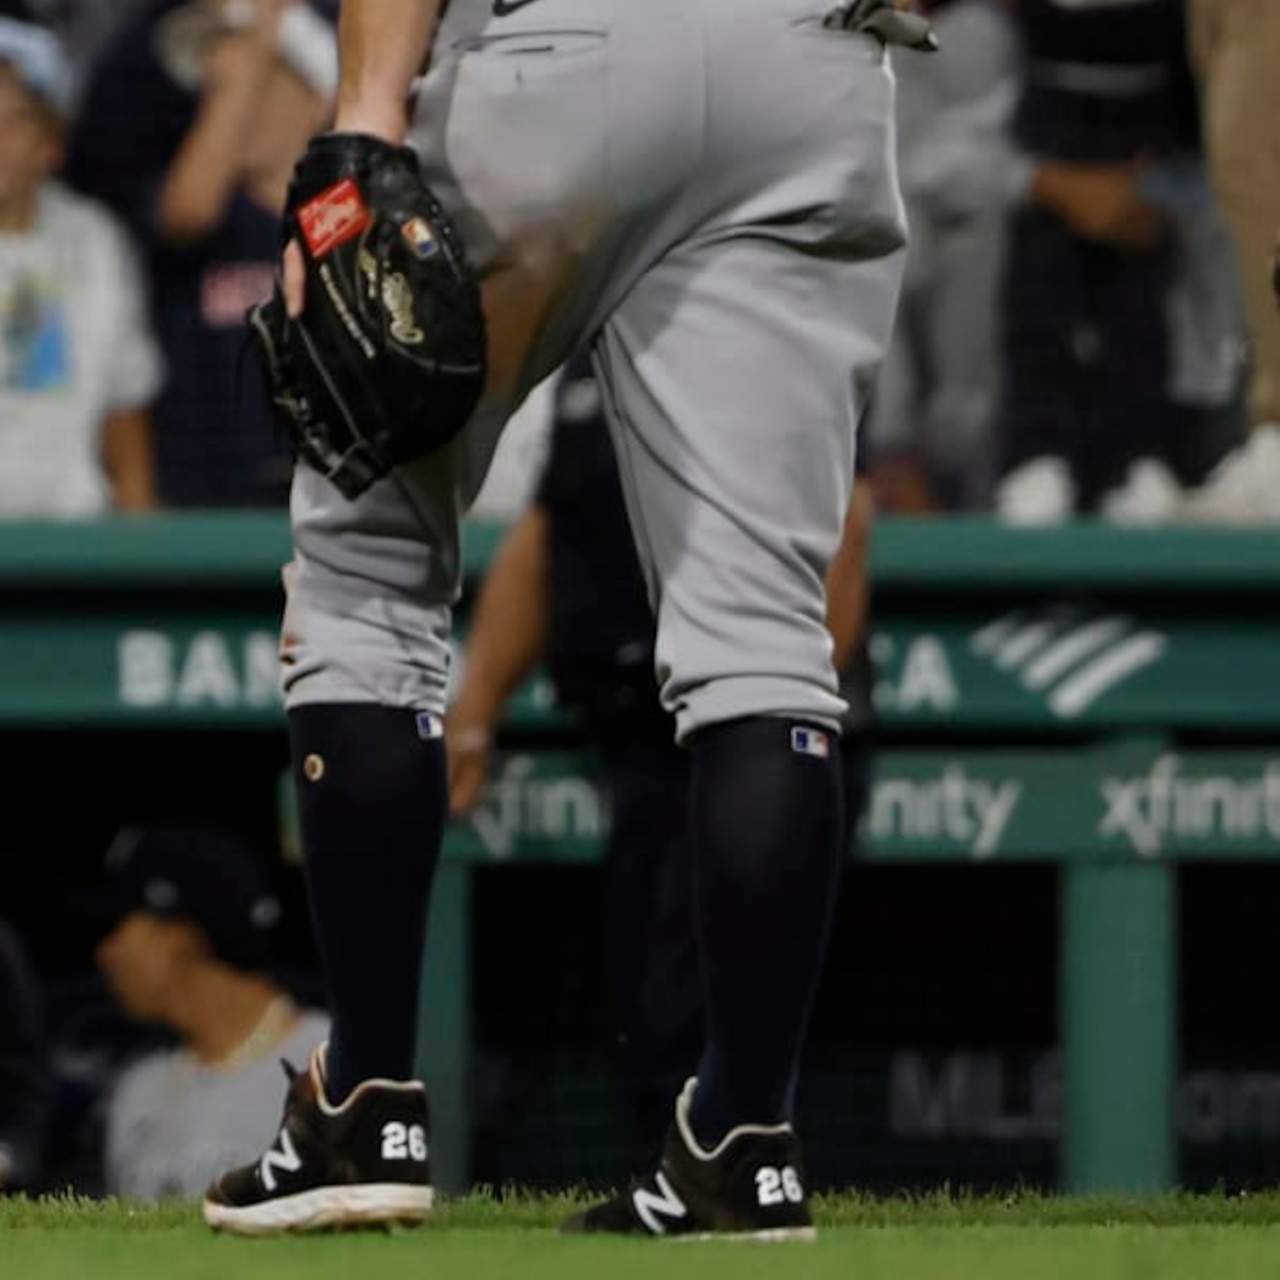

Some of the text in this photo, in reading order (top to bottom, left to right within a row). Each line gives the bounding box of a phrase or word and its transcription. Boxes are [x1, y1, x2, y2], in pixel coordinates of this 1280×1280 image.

[118, 630, 282, 708] BAN
[1100, 753, 1280, 858] xfinit
[381, 1121, 427, 1161] 26
[755, 1166, 803, 1207] 26
